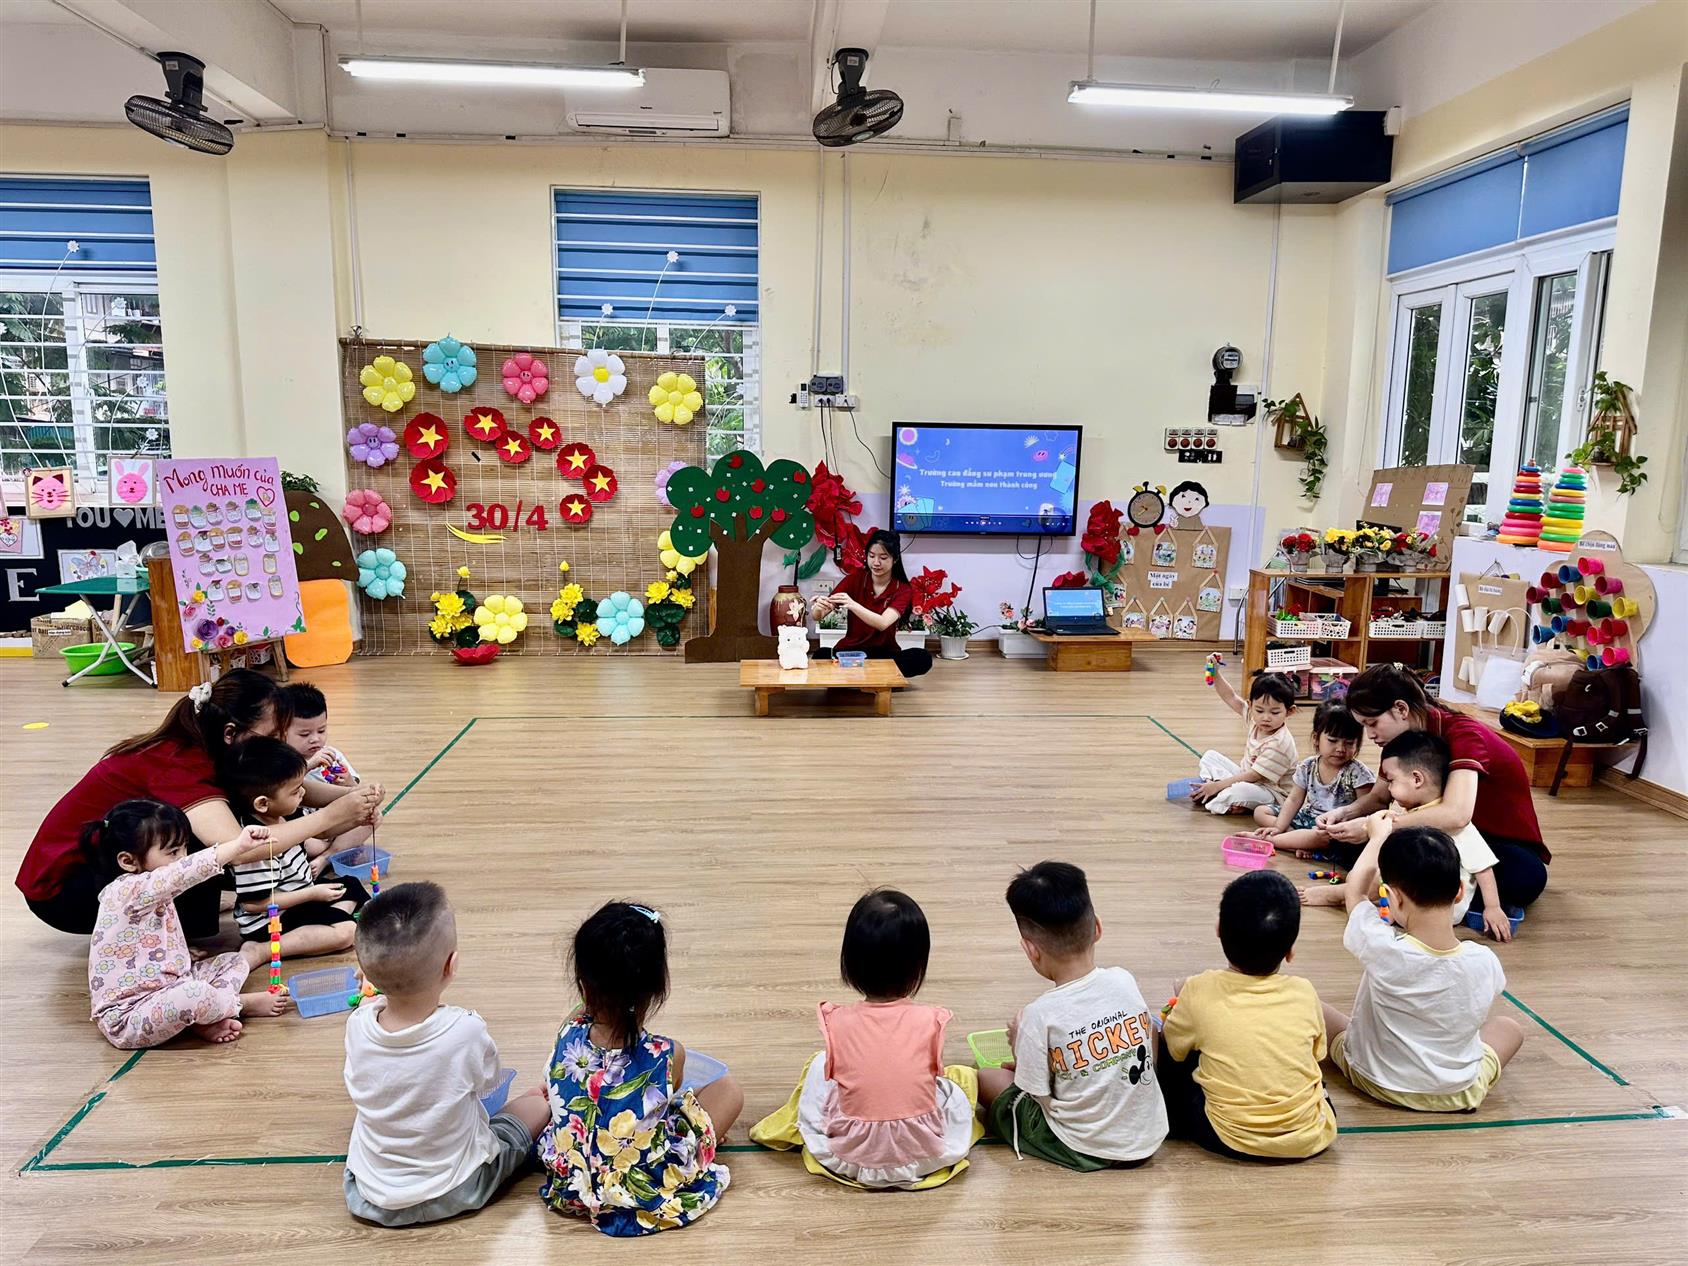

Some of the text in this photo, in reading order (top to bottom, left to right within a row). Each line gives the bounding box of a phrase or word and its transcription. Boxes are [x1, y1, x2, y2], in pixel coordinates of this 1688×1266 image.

[164, 468, 208, 493] Mong
[254, 469, 274, 486] của
[210, 483, 231, 497] CHA
[466, 499, 549, 532] 30/4
[5, 568, 40, 602] E
[1069, 1010, 1128, 1039] THE ORIGINAL
[1048, 1011, 1151, 1073] MICKEY
